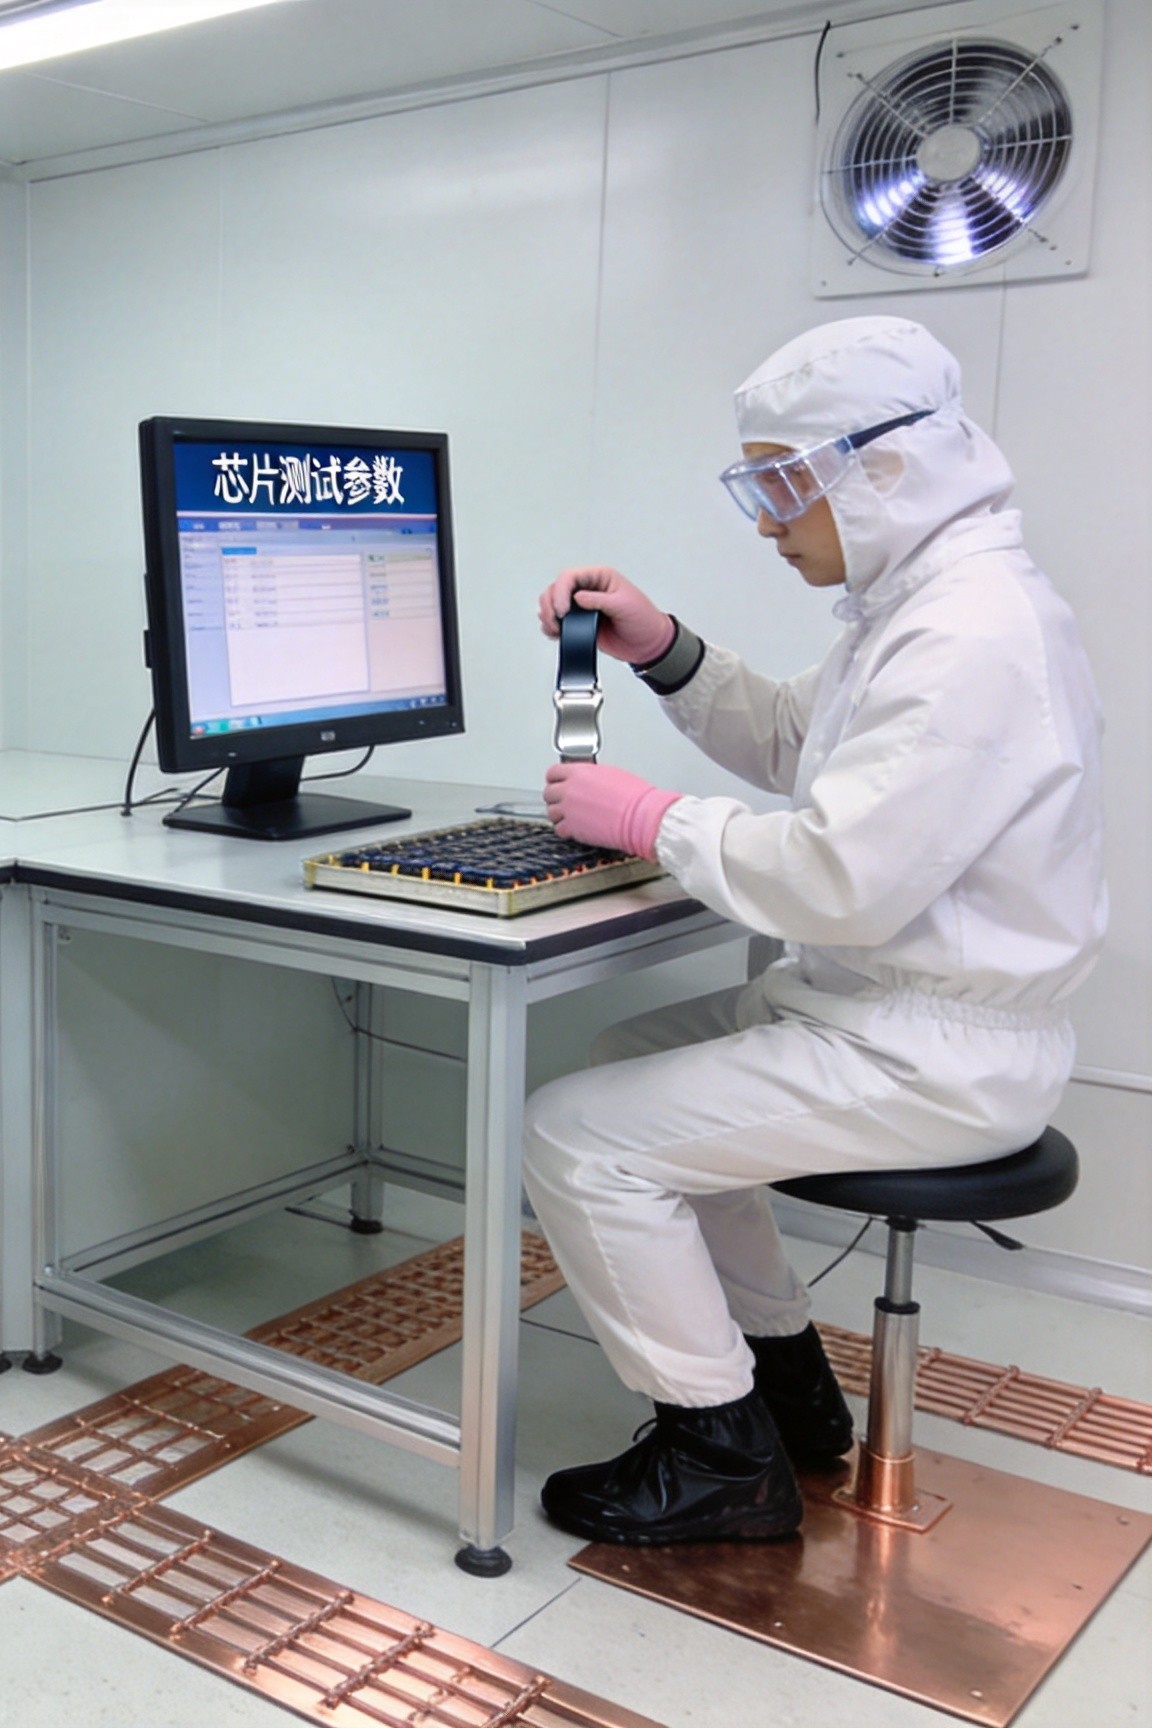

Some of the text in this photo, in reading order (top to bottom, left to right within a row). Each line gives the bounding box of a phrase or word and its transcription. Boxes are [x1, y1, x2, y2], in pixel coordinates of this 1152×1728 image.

[212, 452, 404, 505] 芯片测试参数
